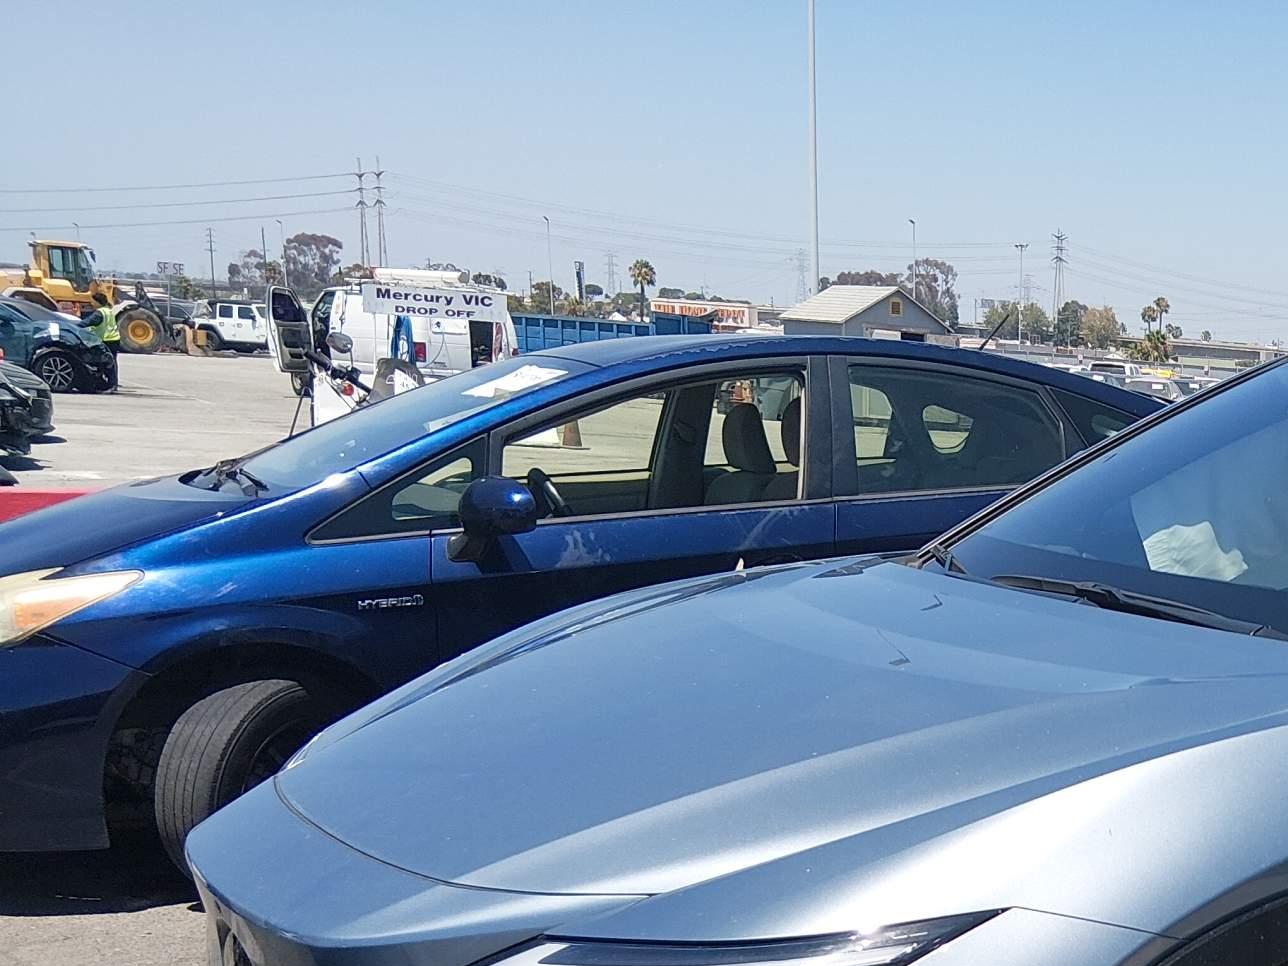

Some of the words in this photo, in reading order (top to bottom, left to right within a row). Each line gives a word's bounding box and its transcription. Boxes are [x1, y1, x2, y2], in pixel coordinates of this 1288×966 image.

[375, 287, 454, 306] Mercury
[461, 293, 493, 307] VIC
[394, 305, 439, 316] DROP
[444, 308, 476, 318] OFF
[358, 597, 413, 609] HYBRID
